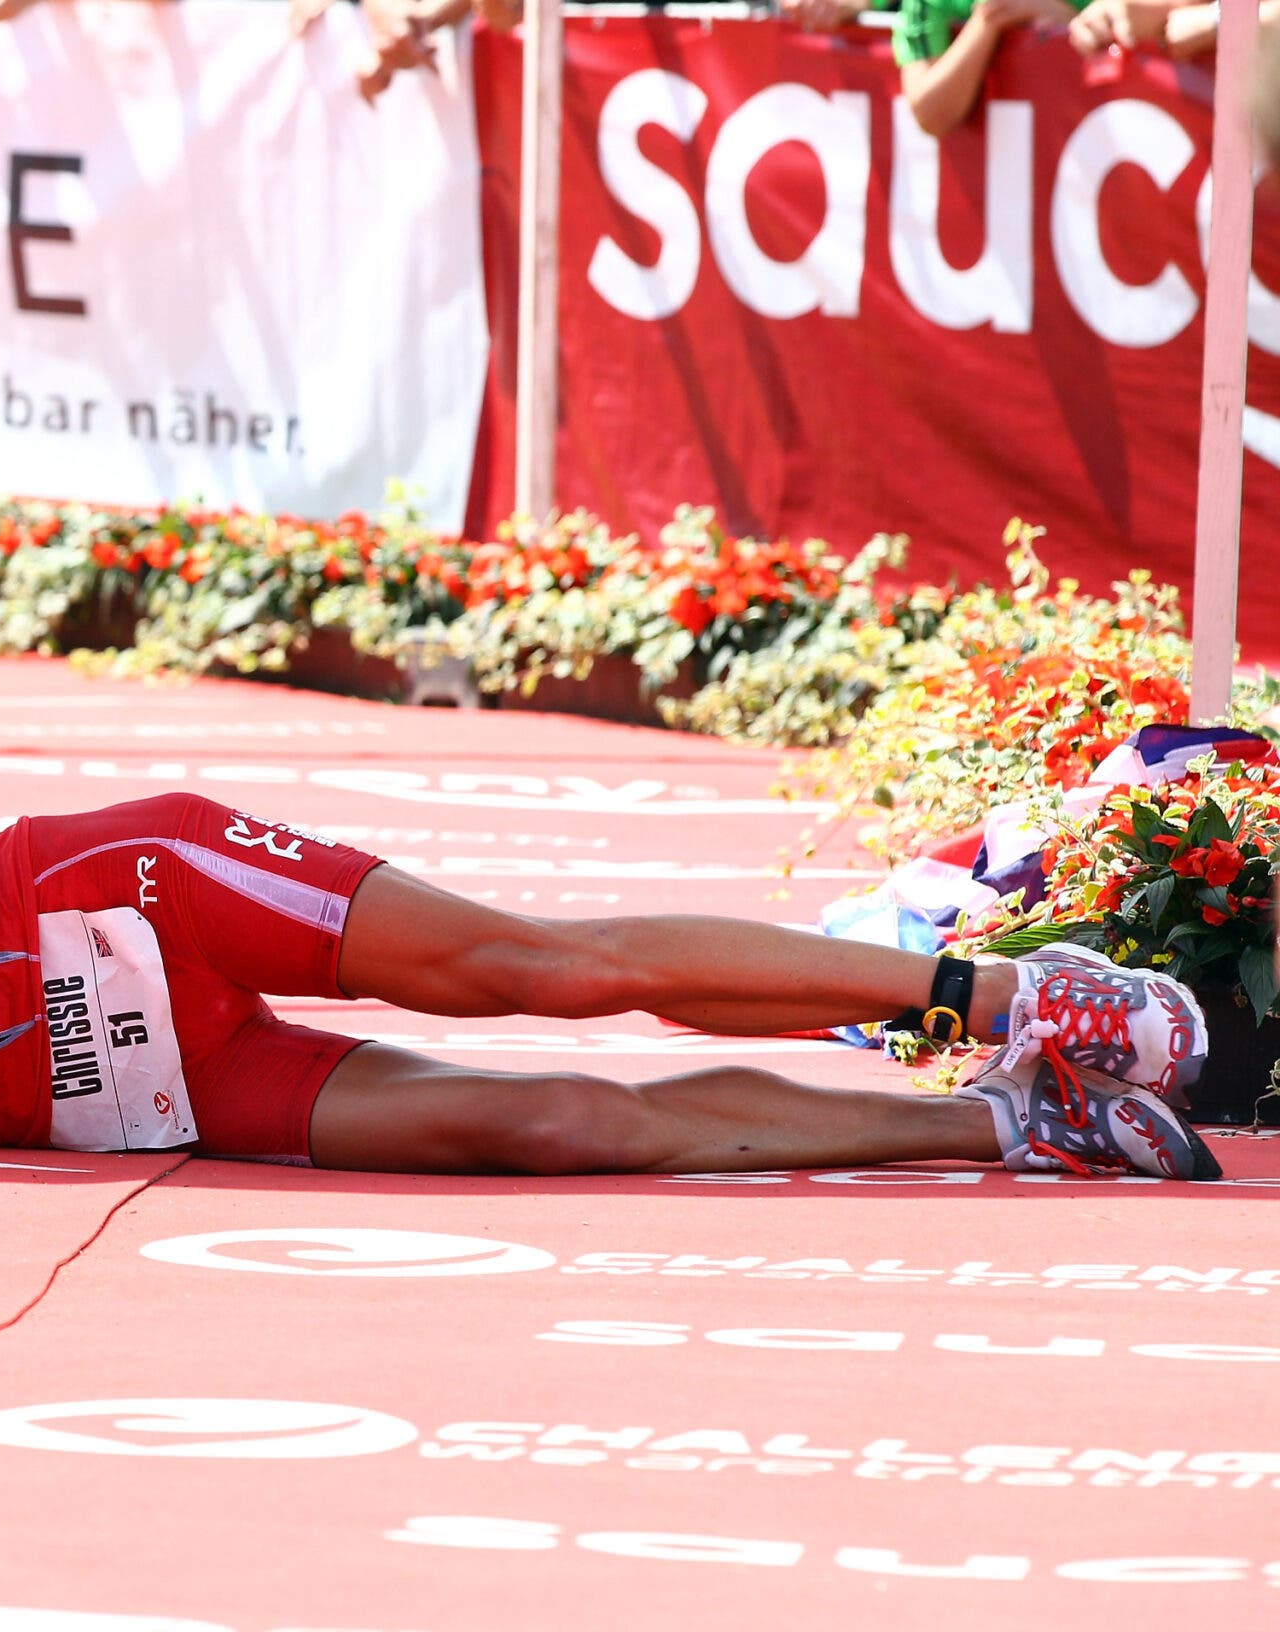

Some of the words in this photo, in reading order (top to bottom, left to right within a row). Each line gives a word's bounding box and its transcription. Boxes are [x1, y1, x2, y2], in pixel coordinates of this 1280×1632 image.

[127, 392, 308, 456] näher.
[224, 815, 304, 862] TYR
[136, 855, 158, 909] TYR
[43, 974, 103, 1101] Chrissie
[108, 1011, 149, 1049] 51
[384, 1515, 1280, 1588] sauc
